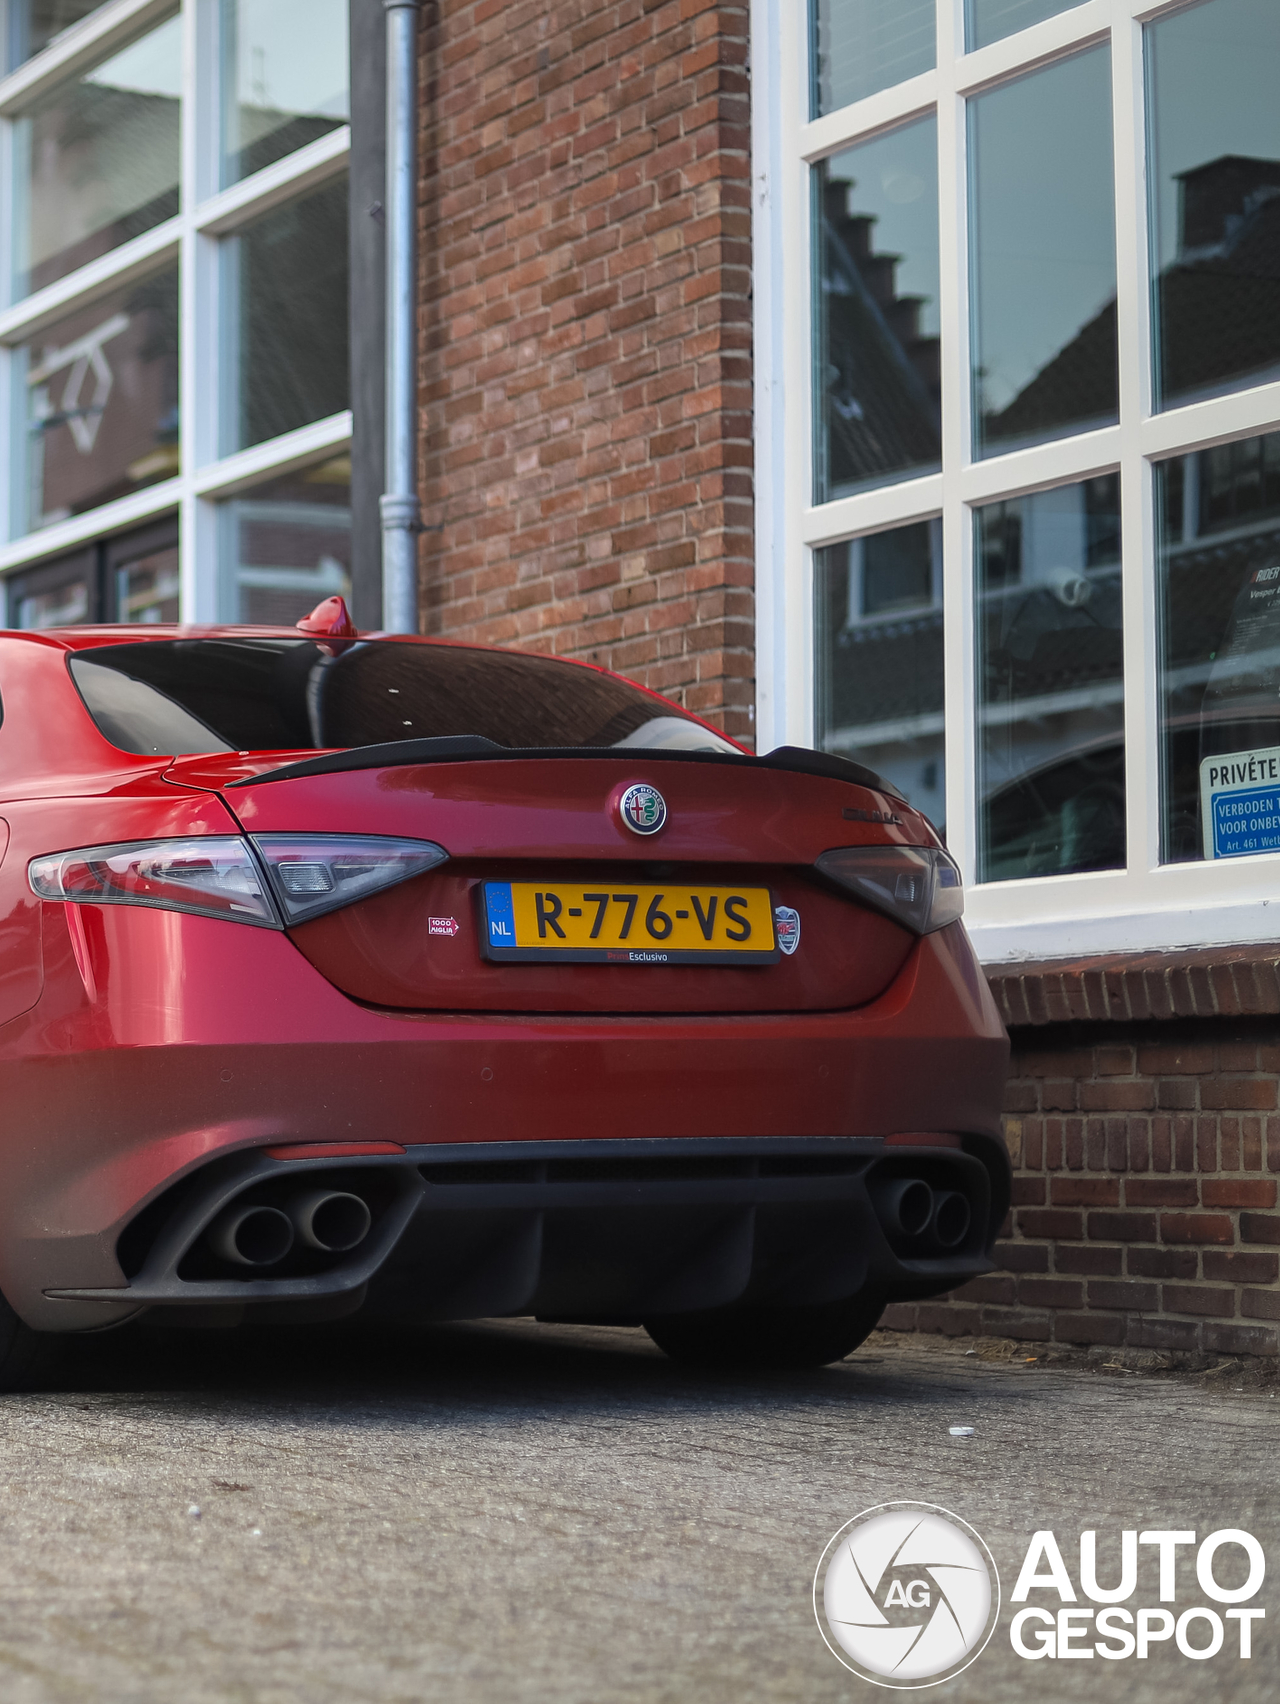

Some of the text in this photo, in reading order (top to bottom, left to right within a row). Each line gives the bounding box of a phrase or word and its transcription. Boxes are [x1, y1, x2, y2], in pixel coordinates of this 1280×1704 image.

[1210, 757, 1280, 787] PRIVÉTE
[625, 787, 663, 810] ALFA ROMEO
[1219, 799, 1273, 817] VERBODEN
[1220, 820, 1247, 835] VOOR
[1227, 841, 1241, 851] Art.
[1243, 838, 1257, 849] 461
[535, 892, 751, 941] R-776-VS
[491, 921, 511, 936] NL
